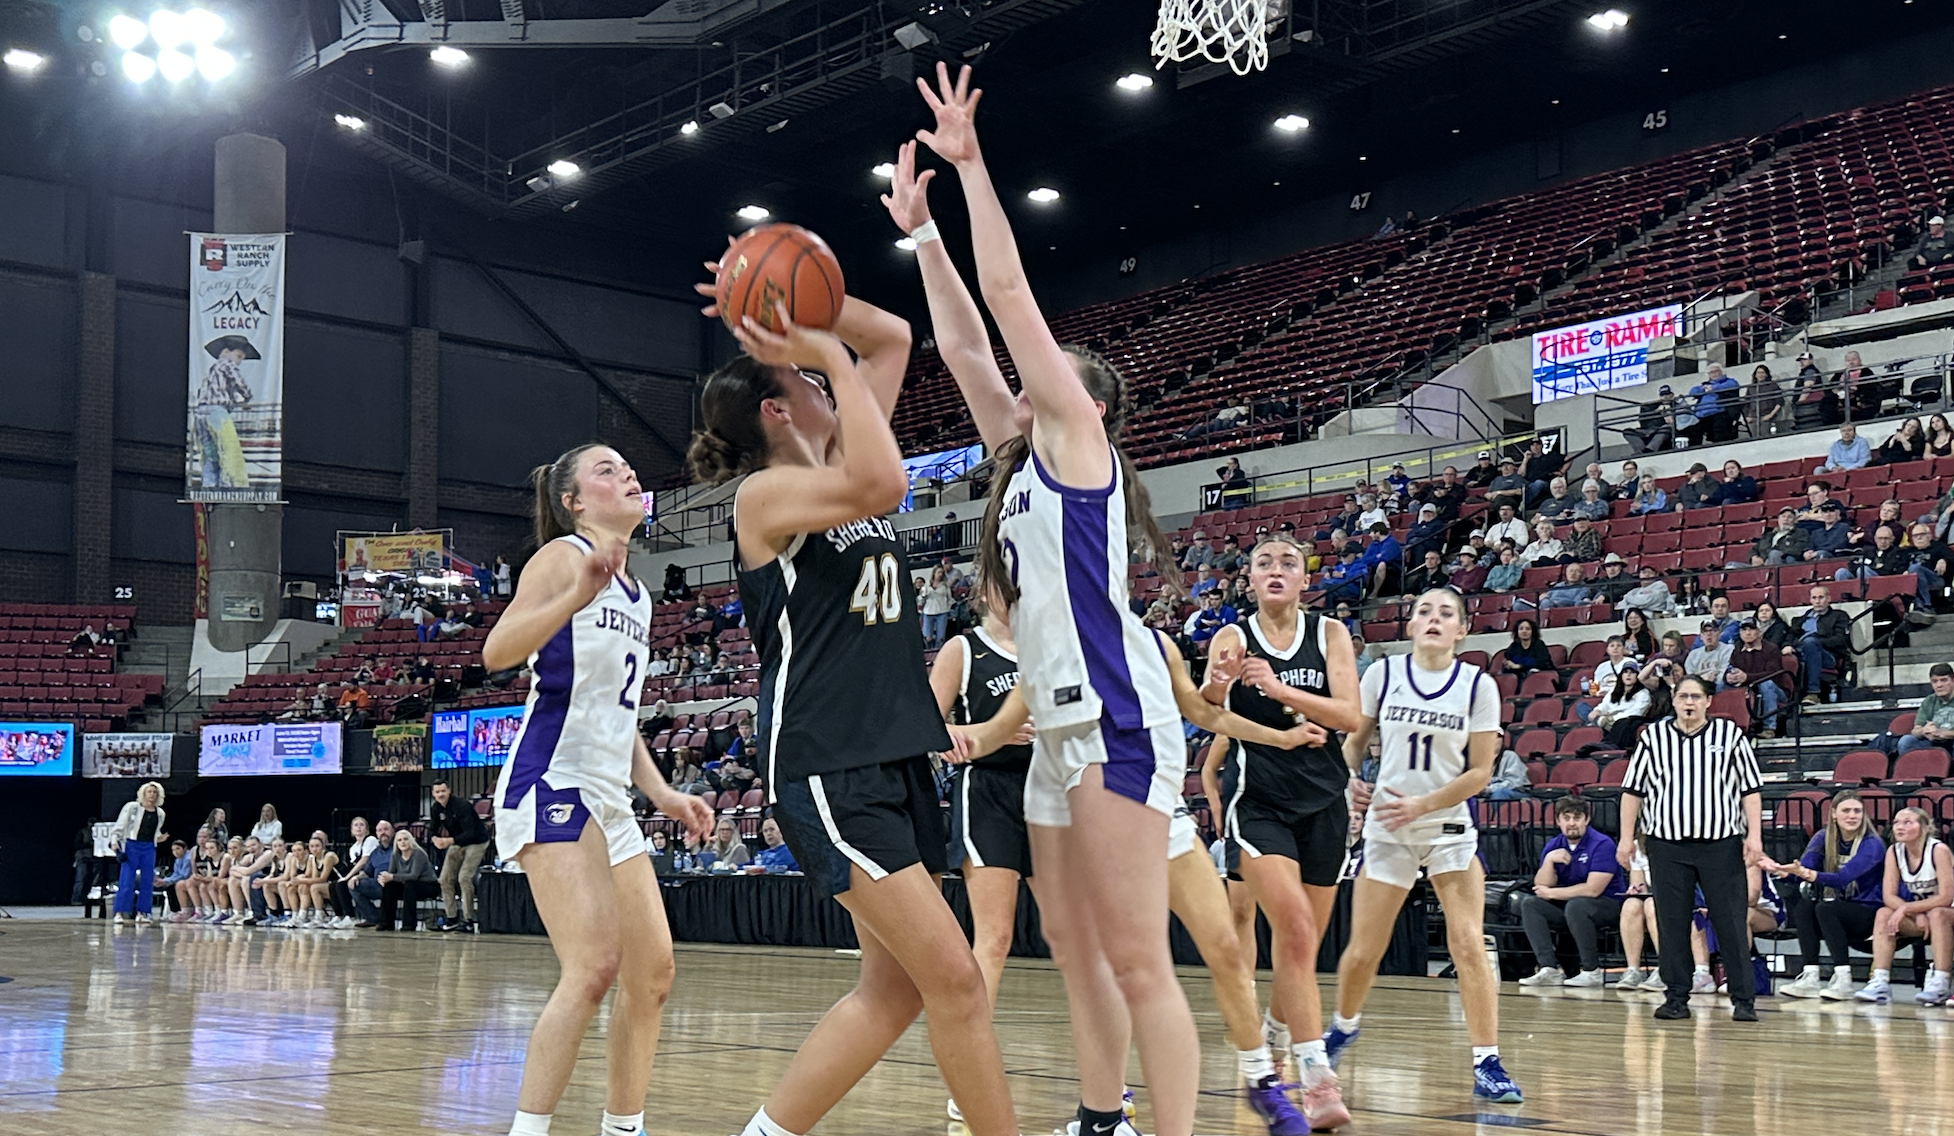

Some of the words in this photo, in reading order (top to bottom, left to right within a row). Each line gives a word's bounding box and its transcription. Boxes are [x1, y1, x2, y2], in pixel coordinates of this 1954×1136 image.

[1643, 110, 1667, 129] 45
[1350, 191, 1371, 210] 47
[1120, 257, 1136, 272] 49
[213, 317, 260, 329] LEGACY
[1538, 328, 1590, 359] TIRE
[1206, 490, 1220, 505] 17
[115, 586, 133, 599] 25
[412, 587, 427, 599] 23
[848, 552, 902, 626] 40
[619, 652, 637, 710] 2
[435, 714, 467, 734] Hairball
[1384, 706, 1466, 731] JEFFERSON
[210, 729, 262, 746] MARKET
[1408, 731, 1434, 772] 11
